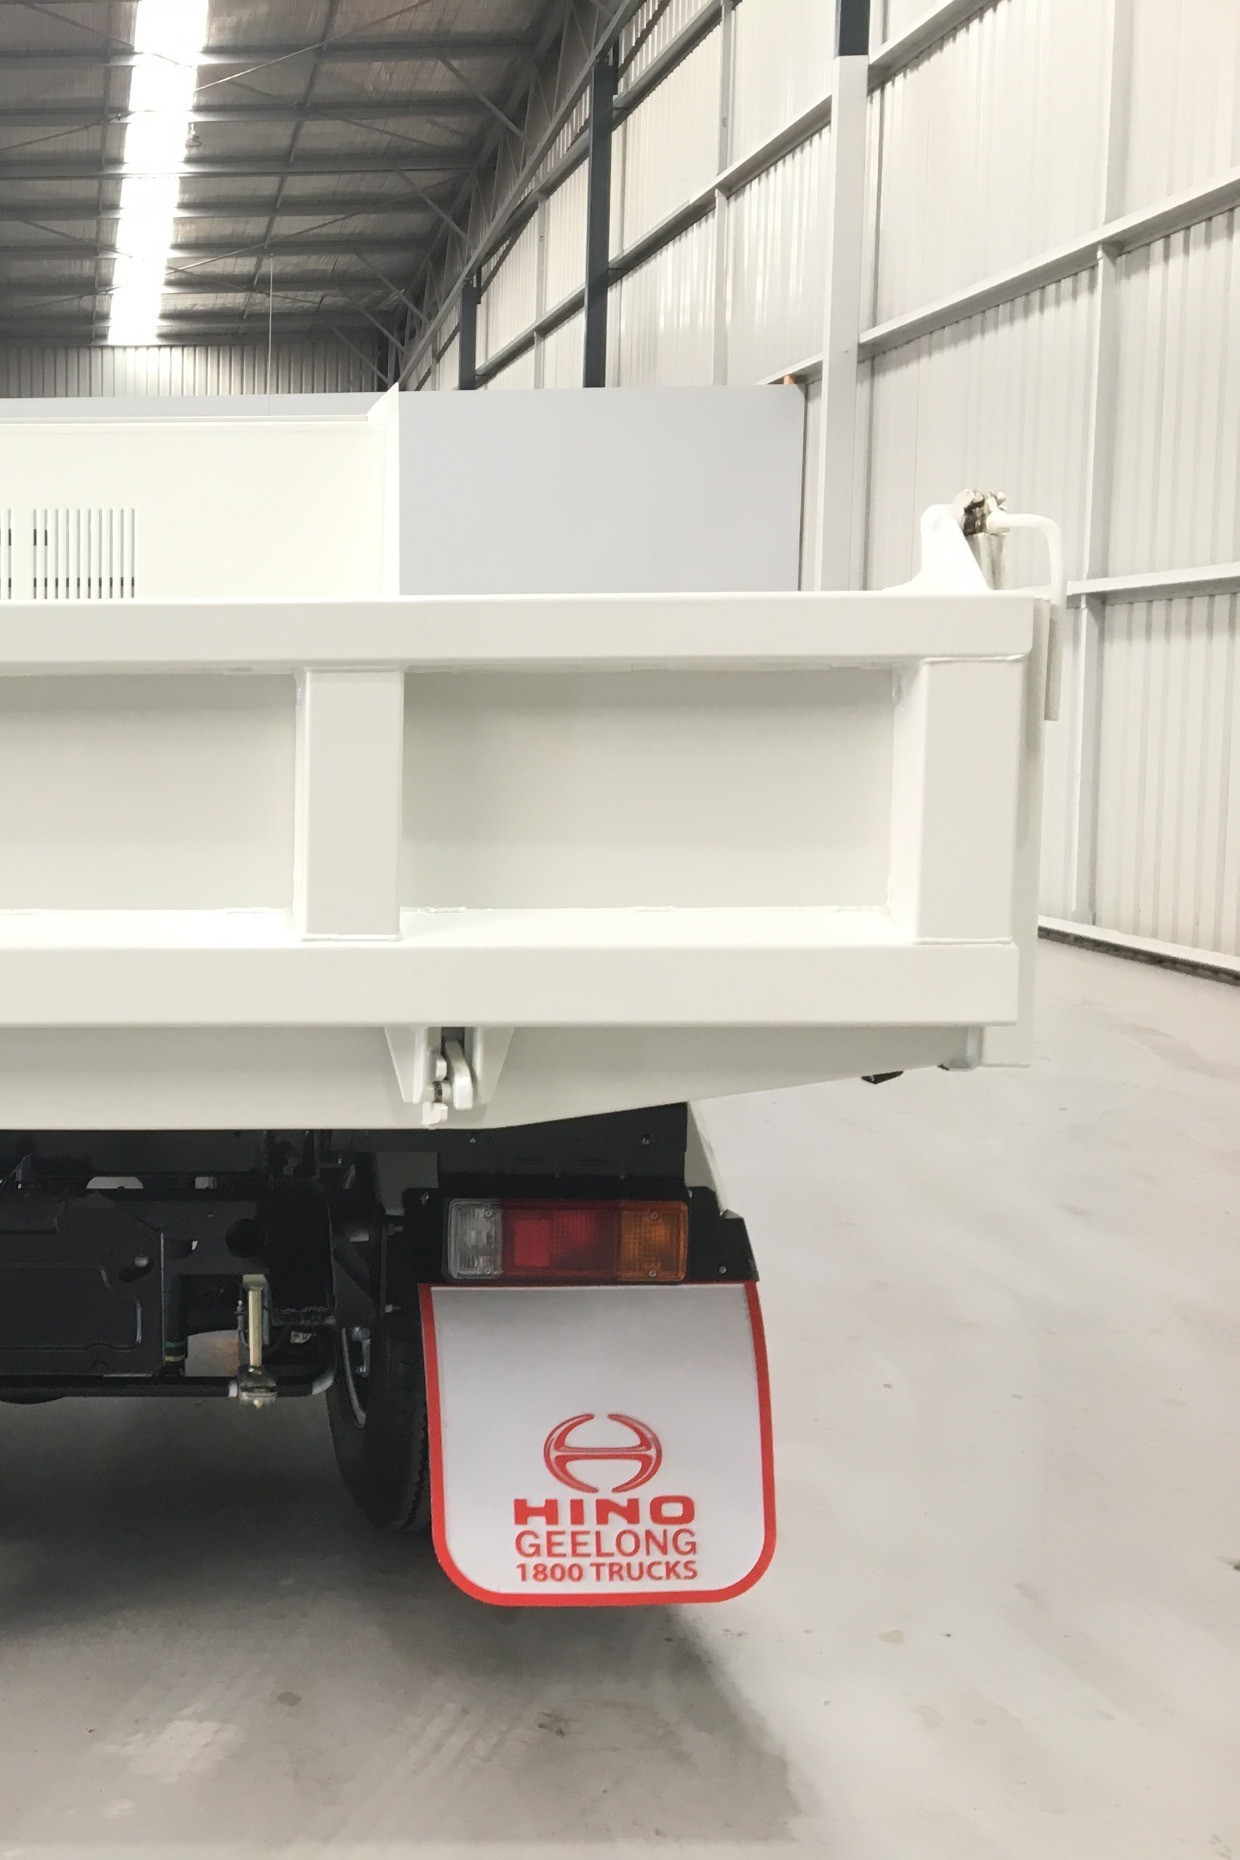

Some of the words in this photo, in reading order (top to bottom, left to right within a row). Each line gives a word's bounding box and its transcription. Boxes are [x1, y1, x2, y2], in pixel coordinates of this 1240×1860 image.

[513, 1495, 696, 1526] HINO
[514, 1528, 697, 1558] GEELONG
[516, 1562, 584, 1583] 1800
[589, 1559, 698, 1583] TRUCKS
